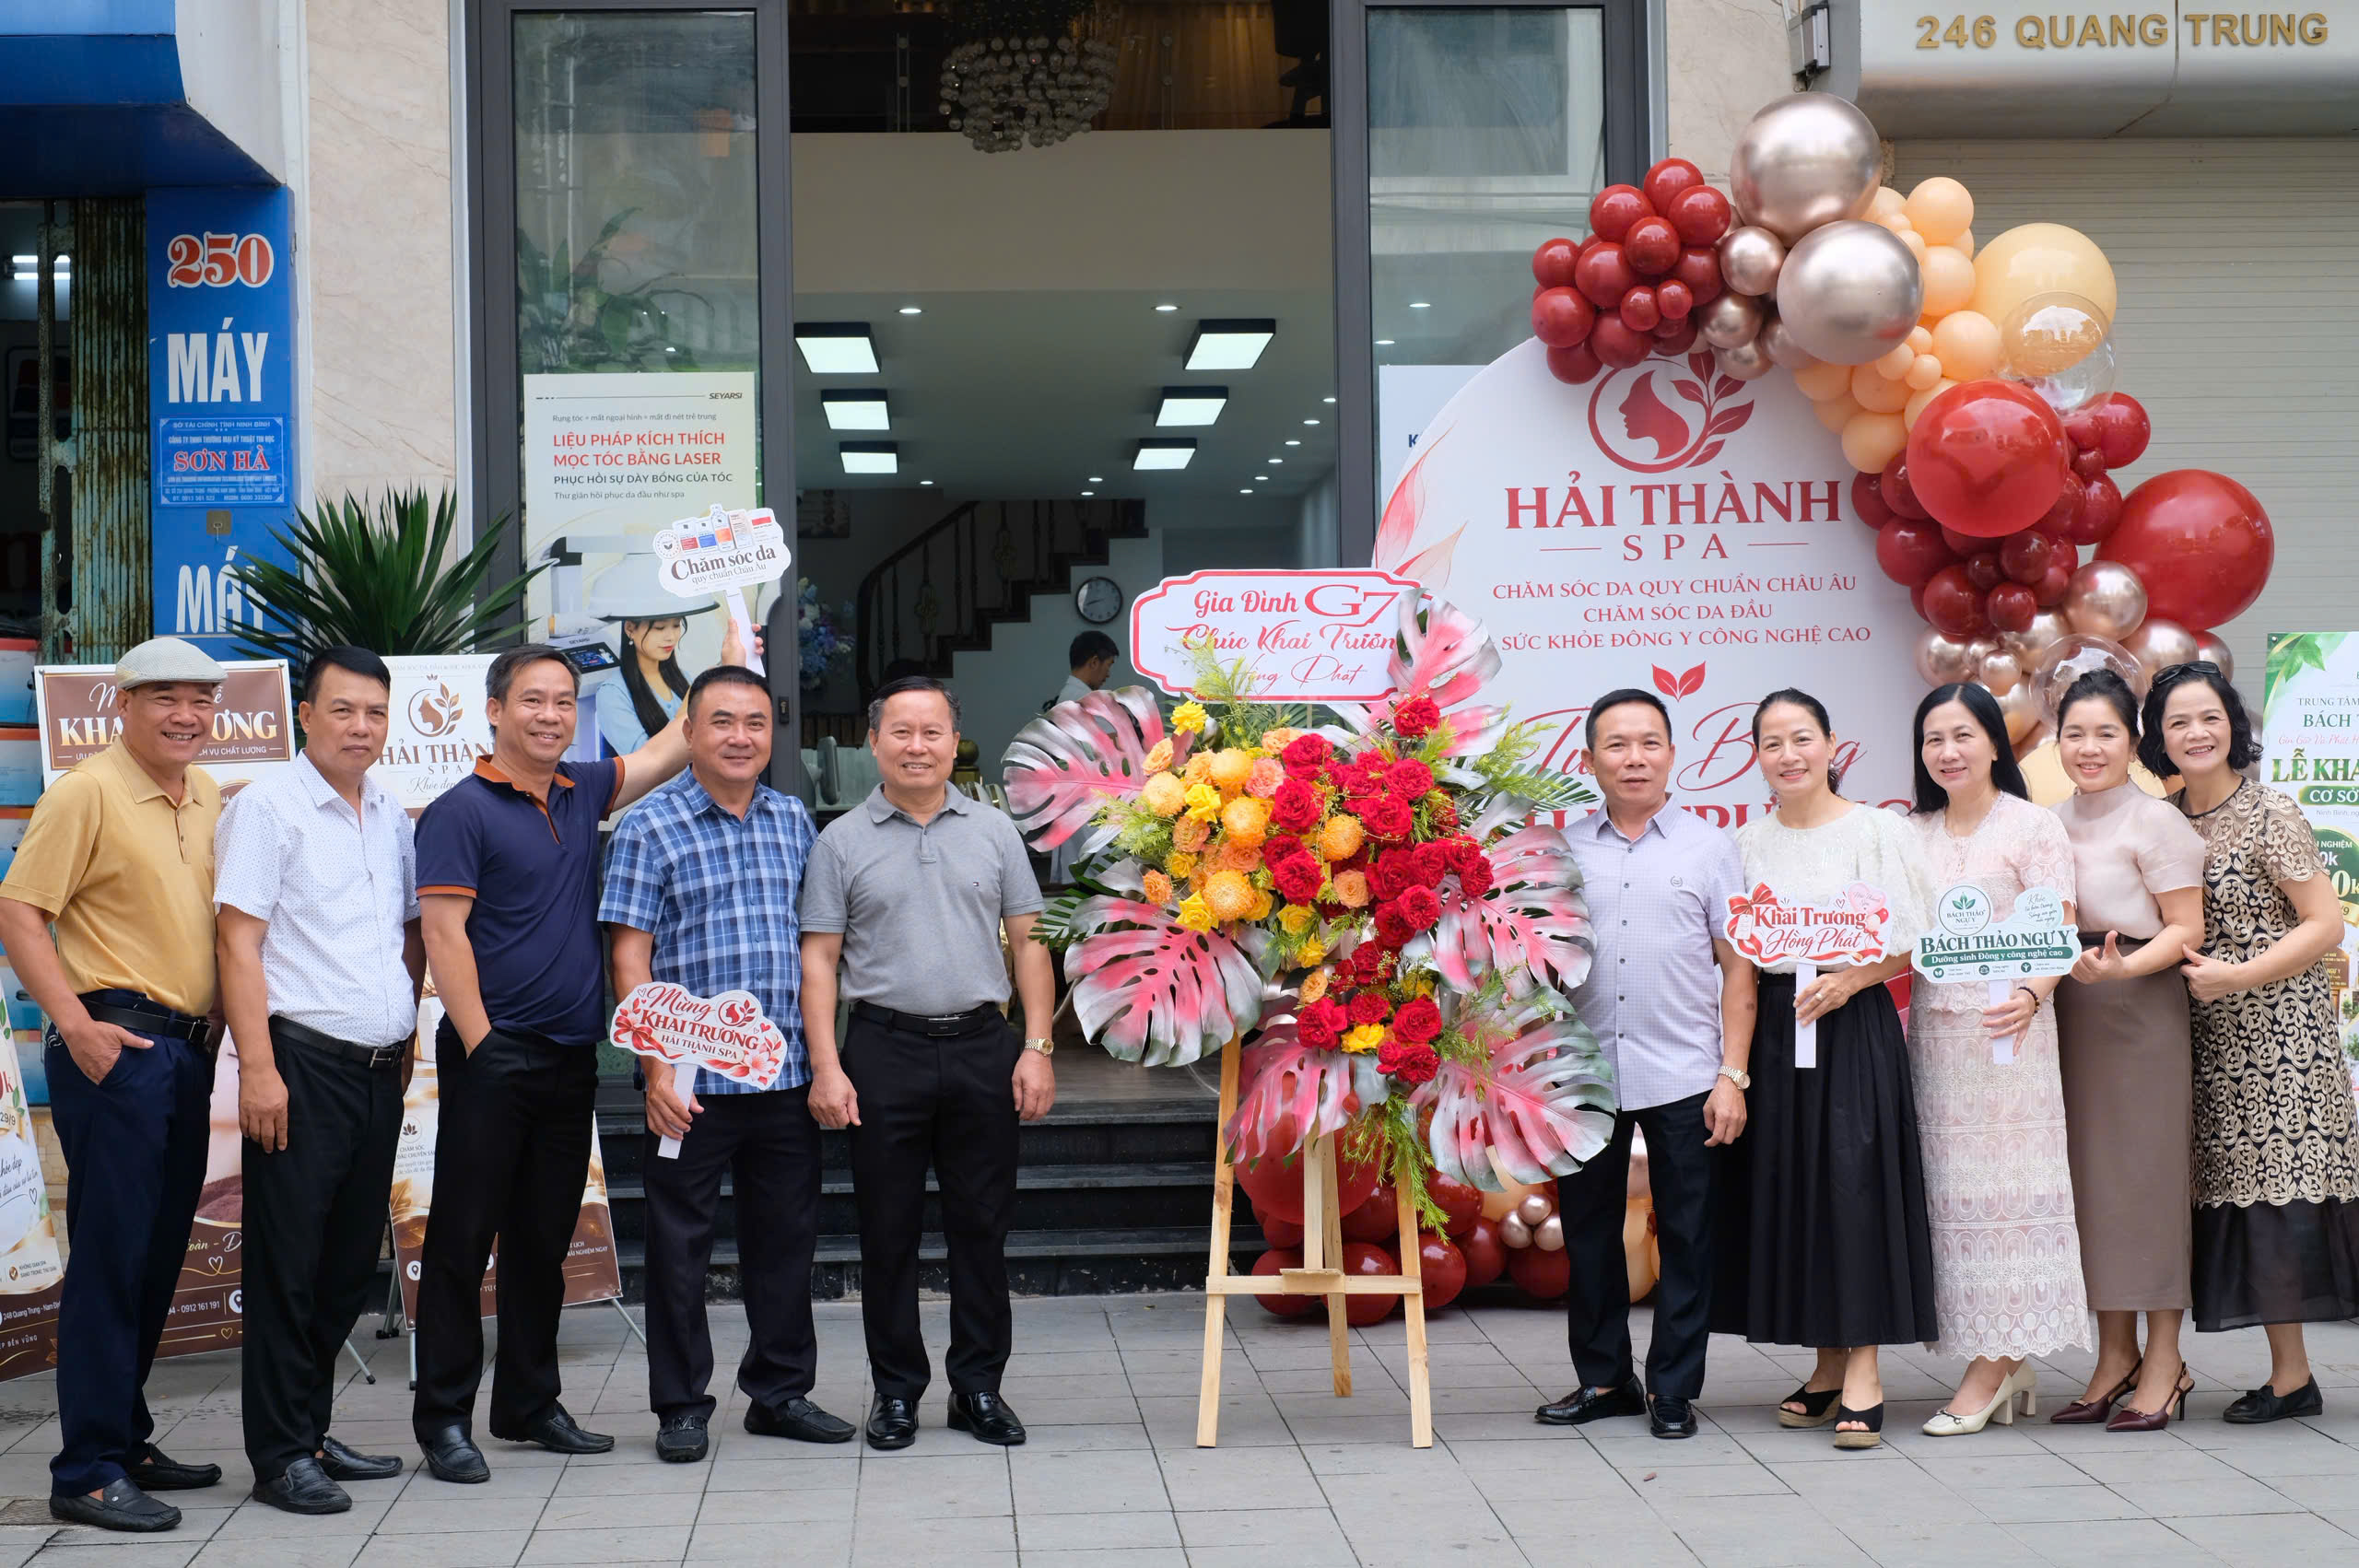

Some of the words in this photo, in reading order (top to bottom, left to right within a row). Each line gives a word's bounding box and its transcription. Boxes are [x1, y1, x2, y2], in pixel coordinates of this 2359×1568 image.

[1915, 15, 1998, 49] 246
[2015, 14, 2168, 50] QUANG
[2184, 13, 2329, 46] TRUNG
[168, 231, 275, 288] 250
[168, 317, 269, 404] MÁY
[554, 431, 586, 450] LIỆU
[591, 430, 633, 446] PHÁP
[637, 429, 674, 445] KÍCH
[677, 429, 724, 445] THÍCH
[173, 448, 227, 473] SƠN
[232, 444, 270, 471] HÀ
[554, 454, 590, 470] MỌC
[593, 451, 624, 466] TÓC
[628, 448, 670, 465] BẰNG
[675, 452, 722, 465] LASER
[554, 475, 584, 486] PHỤC
[587, 472, 606, 484] HỒI
[609, 474, 624, 485] SỰ
[627, 473, 649, 483] DÀY
[686, 472, 709, 482] CỦA
[710, 472, 733, 482] TÓC
[1504, 469, 1616, 530] HẢI
[1629, 470, 1841, 527] THÀNH
[1622, 532, 1730, 561] SPA
[671, 556, 726, 580] Chăm
[728, 550, 753, 567] sóc
[756, 544, 776, 561] da
[692, 573, 708, 584] quy
[709, 568, 734, 581] chuẩn
[734, 565, 754, 578] Châu
[1492, 579, 1555, 600] CHĂM
[1560, 576, 1602, 598] SÓC
[1606, 580, 1635, 597] DA
[1638, 579, 1684, 599] QUY
[1688, 571, 1761, 595] CHUẨN
[1766, 573, 1824, 593] CHÂU
[1828, 573, 1857, 591] ÂU
[1194, 590, 1235, 618] Gia
[1241, 590, 1298, 613] Đình
[1304, 584, 1400, 625] G7
[1583, 604, 1645, 623] CHĂM
[1650, 603, 1692, 621] SÓC
[1696, 603, 1725, 620] DA
[1730, 597, 1773, 619] ĐẦU
[1165, 623, 1250, 649] Chúc
[1257, 619, 1312, 655] Khai
[1501, 629, 1543, 651] SỨC
[1547, 628, 1606, 650] KHỎE
[1610, 627, 1673, 648] ĐÔNG
[1679, 630, 1694, 647] Y
[1698, 626, 1760, 646] CÔNG
[1764, 626, 1823, 646] NGHỆ
[1827, 626, 1872, 643] CAO
[2297, 697, 2334, 706] TRUNG
[58, 715, 123, 745] KHA
[212, 708, 277, 741] ƠNG
[2304, 711, 2351, 727] BÁCH
[209, 747, 219, 756] VỤ
[220, 744, 241, 755] CHẤT
[241, 744, 266, 755] LƯỢNG
[379, 738, 420, 765] HẢI
[426, 738, 495, 764] THÀN
[428, 765, 464, 775] SPA
[2271, 748, 2308, 782] LỄ
[2313, 758, 2359, 782] KHA
[2309, 790, 2333, 802] CƠ
[2337, 786, 2359, 802] SỞ
[2321, 839, 2353, 849] NGHIỆM
[1755, 907, 1797, 929] Khai
[1800, 907, 1866, 930] Trương
[1765, 929, 1814, 957] Hồng
[1815, 927, 1862, 954] Phát
[1920, 934, 1969, 954] BÁCH
[1973, 930, 2018, 949] THẢO
[2021, 930, 2055, 950] NGỰ
[2058, 930, 2071, 945] Y
[1931, 954, 1958, 965] Dưỡng
[1959, 953, 1977, 962] sinh
[1978, 953, 2000, 962] Đông
[2007, 951, 2026, 960] công
[2027, 949, 2048, 959] nghệ
[647, 985, 715, 1022] Mừng
[640, 1009, 687, 1033] KHAI
[688, 1021, 758, 1050] TRƯƠNG
[662, 1034, 680, 1046] HẢI
[682, 1037, 717, 1056] THÀNH
[718, 1047, 737, 1059] SPA
[13, 1309, 28, 1318] Quang
[28, 1306, 41, 1316] Trung
[181, 1304, 196, 1313] 0912
[198, 1303, 208, 1311] 161
[209, 1301, 220, 1309] 191
